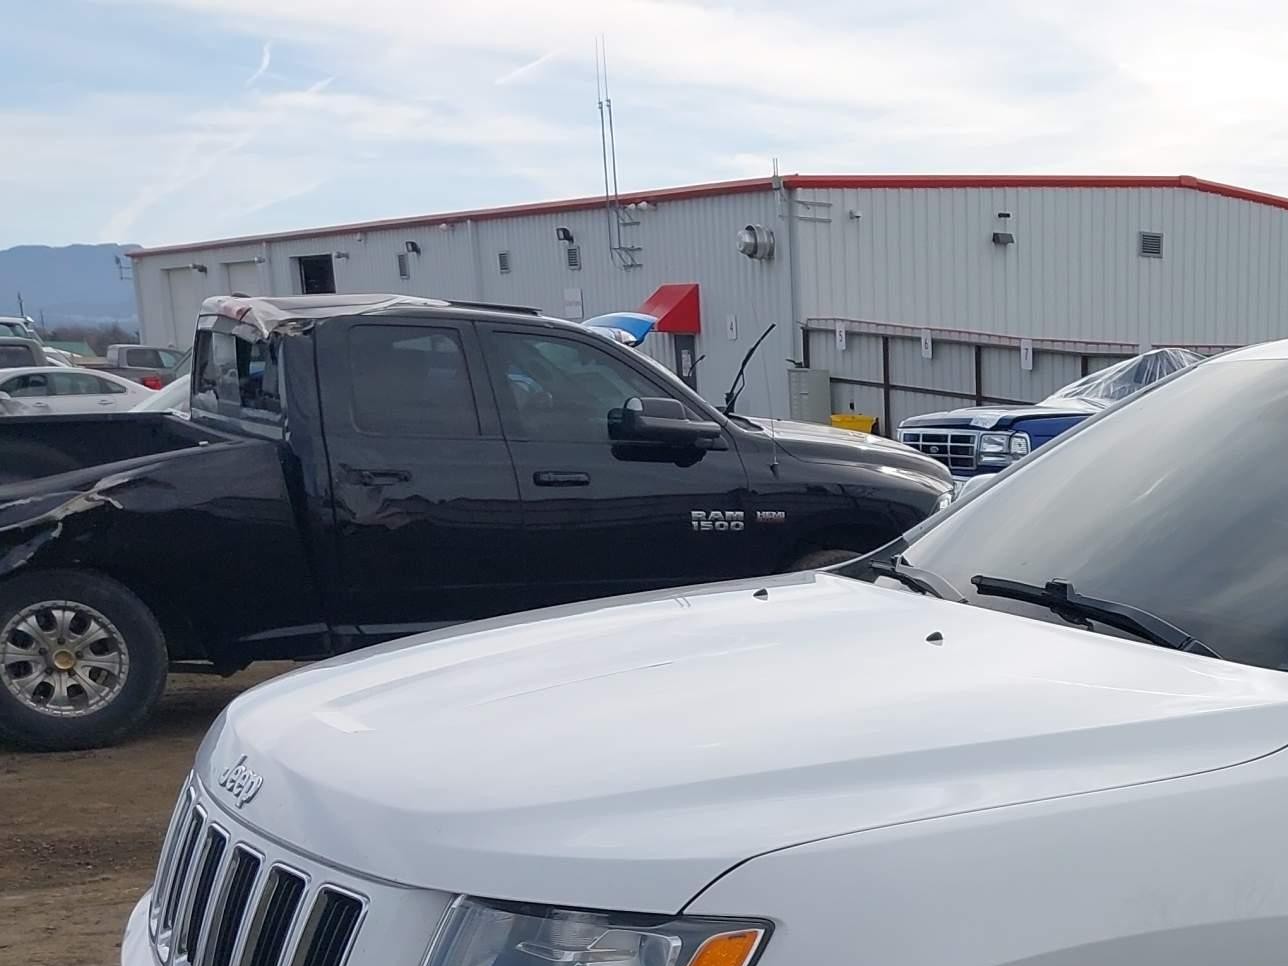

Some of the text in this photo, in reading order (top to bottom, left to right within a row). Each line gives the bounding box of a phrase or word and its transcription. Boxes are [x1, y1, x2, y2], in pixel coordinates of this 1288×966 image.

[690, 510, 786, 520] RAM HEMI
[691, 521, 745, 531] 1500
[219, 753, 264, 810] Jeep
